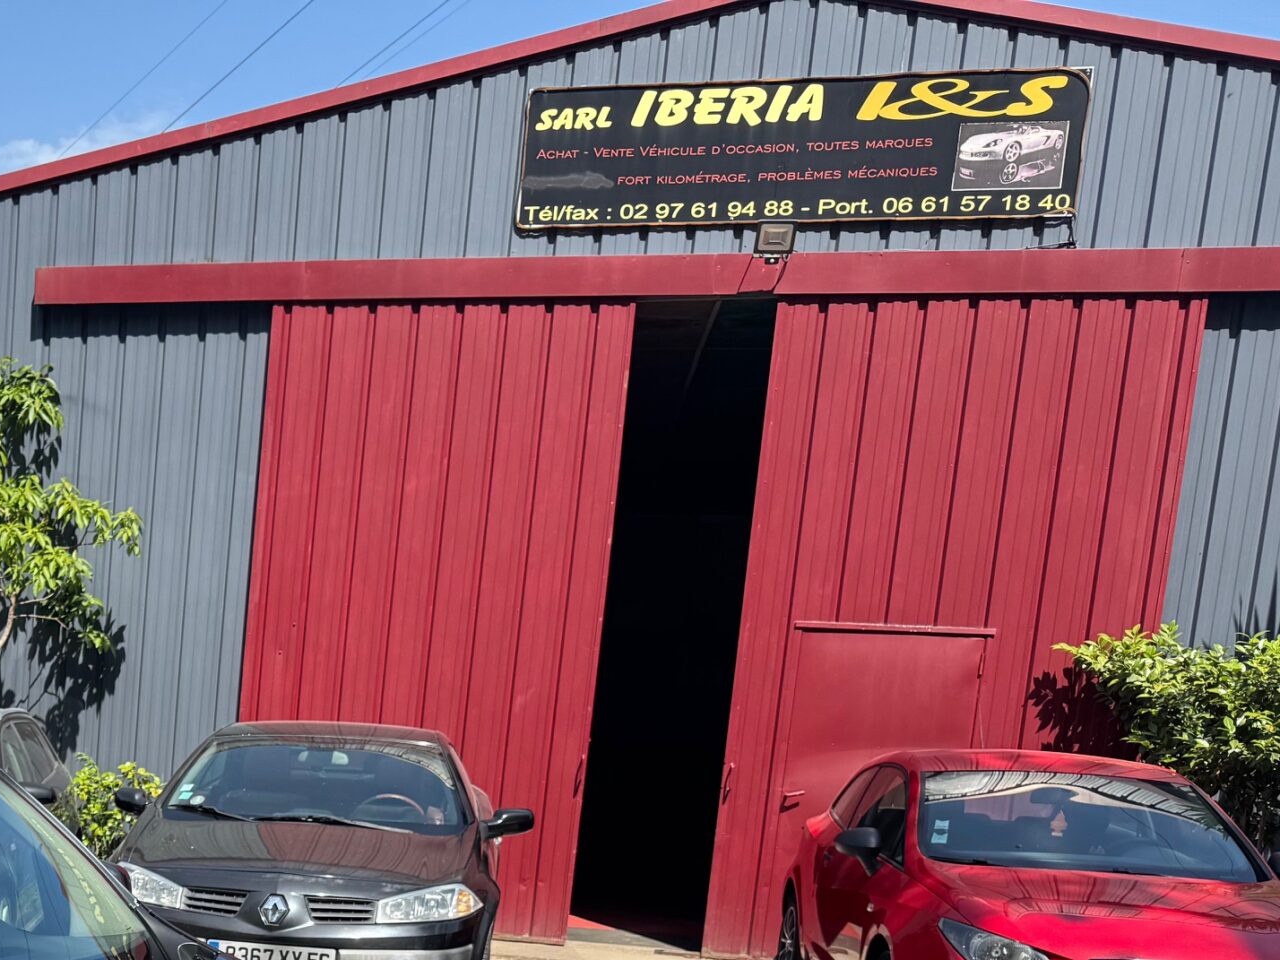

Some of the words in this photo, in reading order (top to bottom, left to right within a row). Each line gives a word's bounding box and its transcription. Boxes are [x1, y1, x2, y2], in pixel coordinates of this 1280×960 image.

[535, 106, 612, 132] SARL
[630, 84, 824, 128] IBERIA
[537, 149, 578, 160] ACHAT
[593, 147, 634, 158] VENTE
[807, 140, 859, 151] TOUTES
[866, 137, 933, 150] MARQUES
[617, 175, 651, 186] FORT
[656, 171, 751, 185] KILOMÉTRAGE,
[758, 168, 842, 182] PROBLÈMES
[848, 164, 937, 179] MÉCANIQUES
[525, 205, 598, 222] Tél/fax
[620, 204, 648, 219] 02
[655, 202, 684, 219] 97
[691, 202, 717, 218] 61
[728, 201, 756, 217] 94
[764, 200, 794, 216] 88
[818, 198, 873, 215] Port.
[883, 197, 913, 213] 06
[920, 196, 948, 212] 61
[959, 195, 990, 212] 57
[1002, 195, 1030, 211] 18
[1039, 194, 1071, 210] 40
